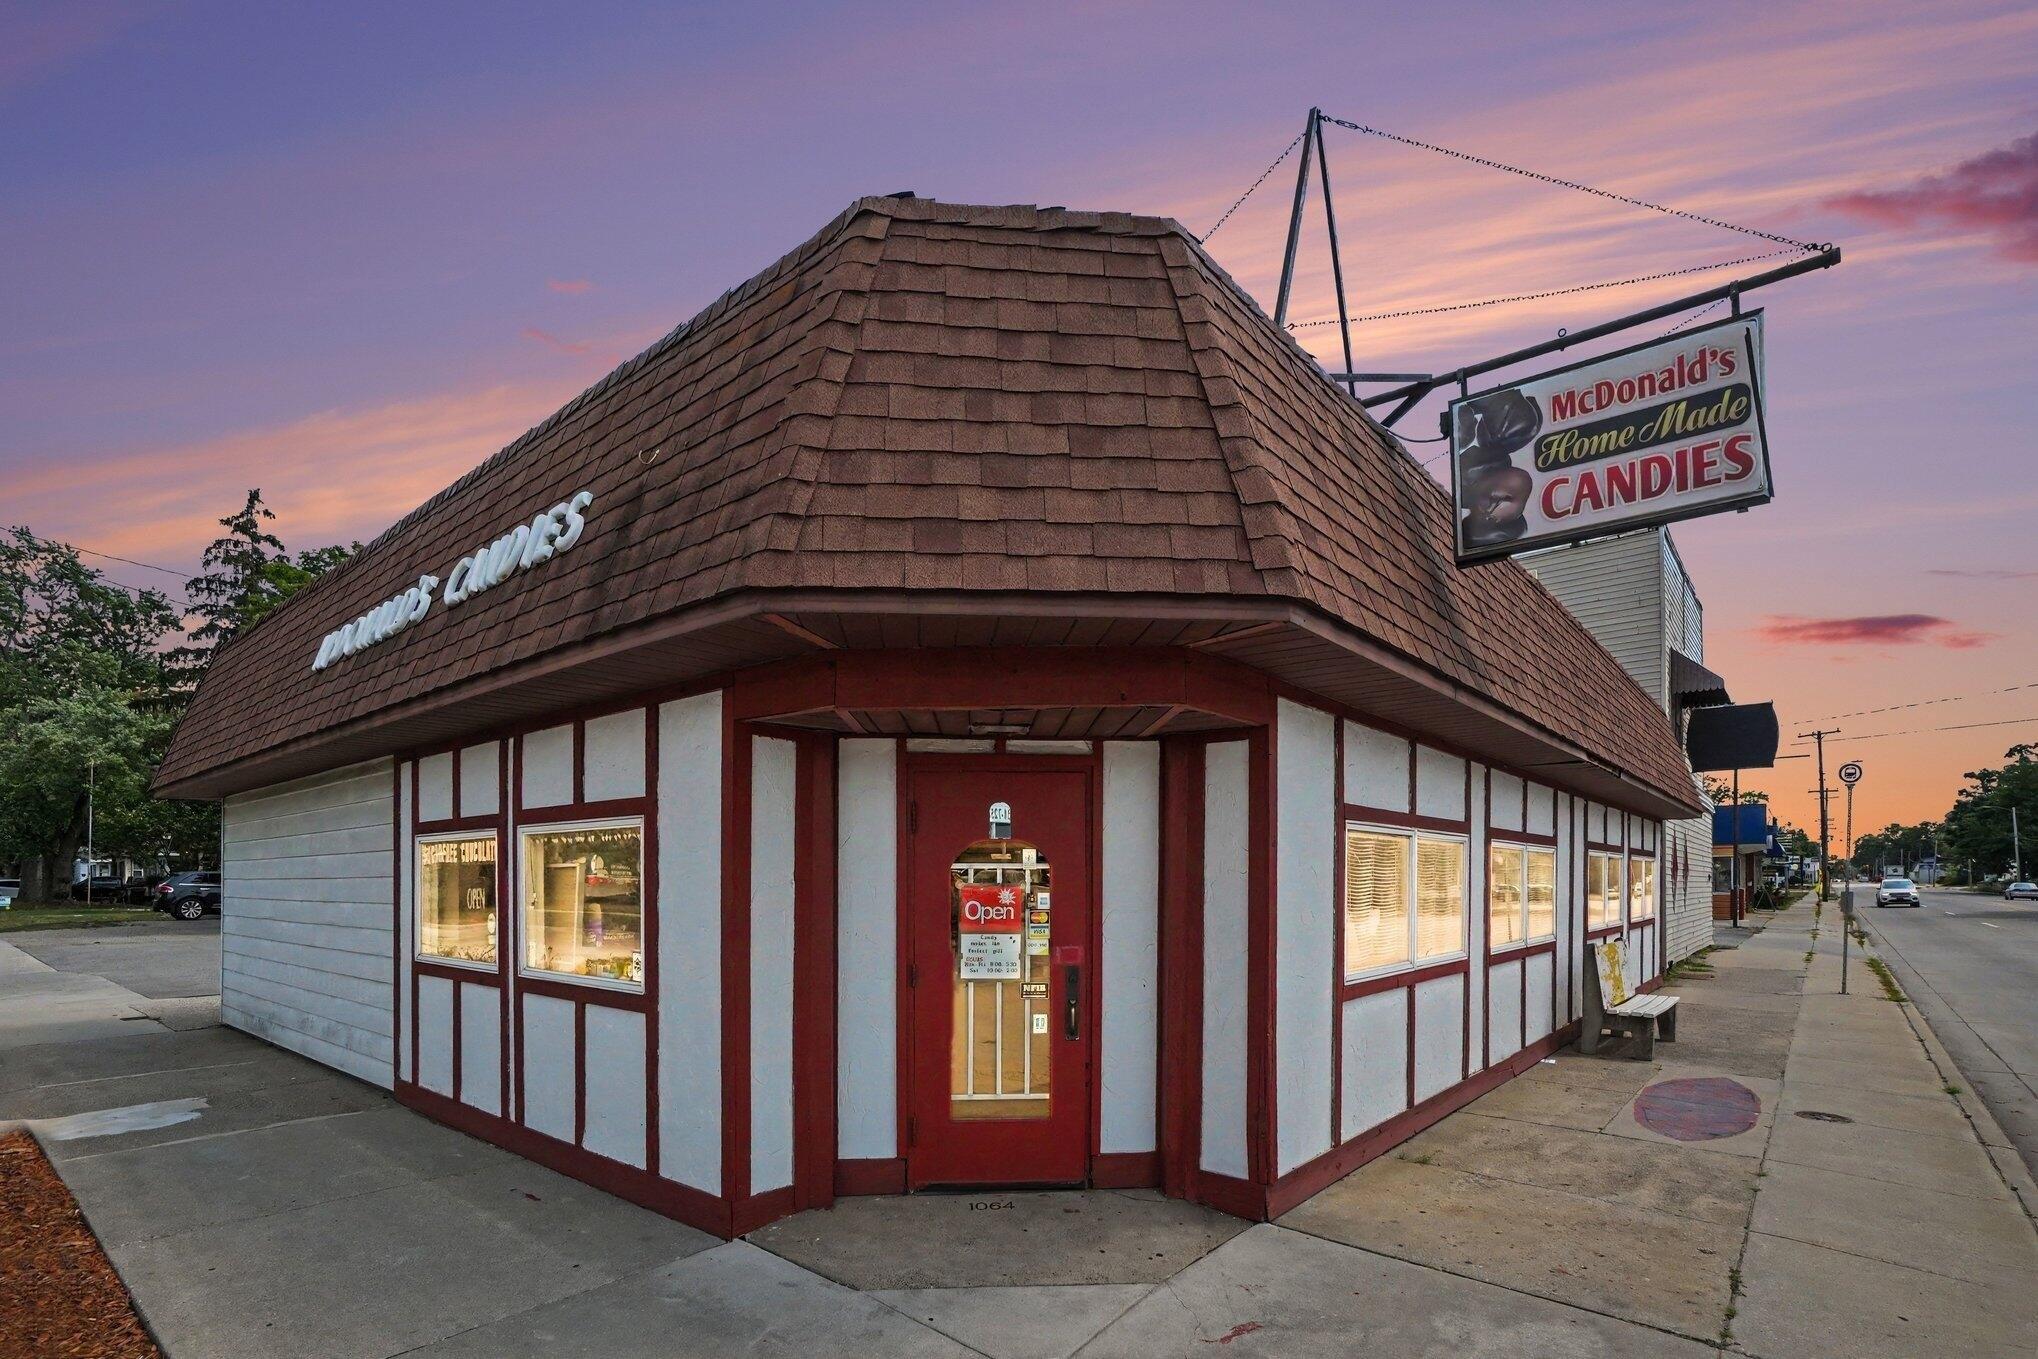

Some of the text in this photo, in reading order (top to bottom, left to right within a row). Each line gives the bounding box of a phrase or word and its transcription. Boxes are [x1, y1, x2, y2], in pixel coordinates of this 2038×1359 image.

[1551, 346, 1736, 423] McDonald's
[1537, 389, 1748, 468] Home Made
[1540, 434, 1756, 520] CANDIES
[466, 888, 486, 910] OPEN
[964, 900, 1015, 925] Open
[968, 1201, 1015, 1211] 1064
